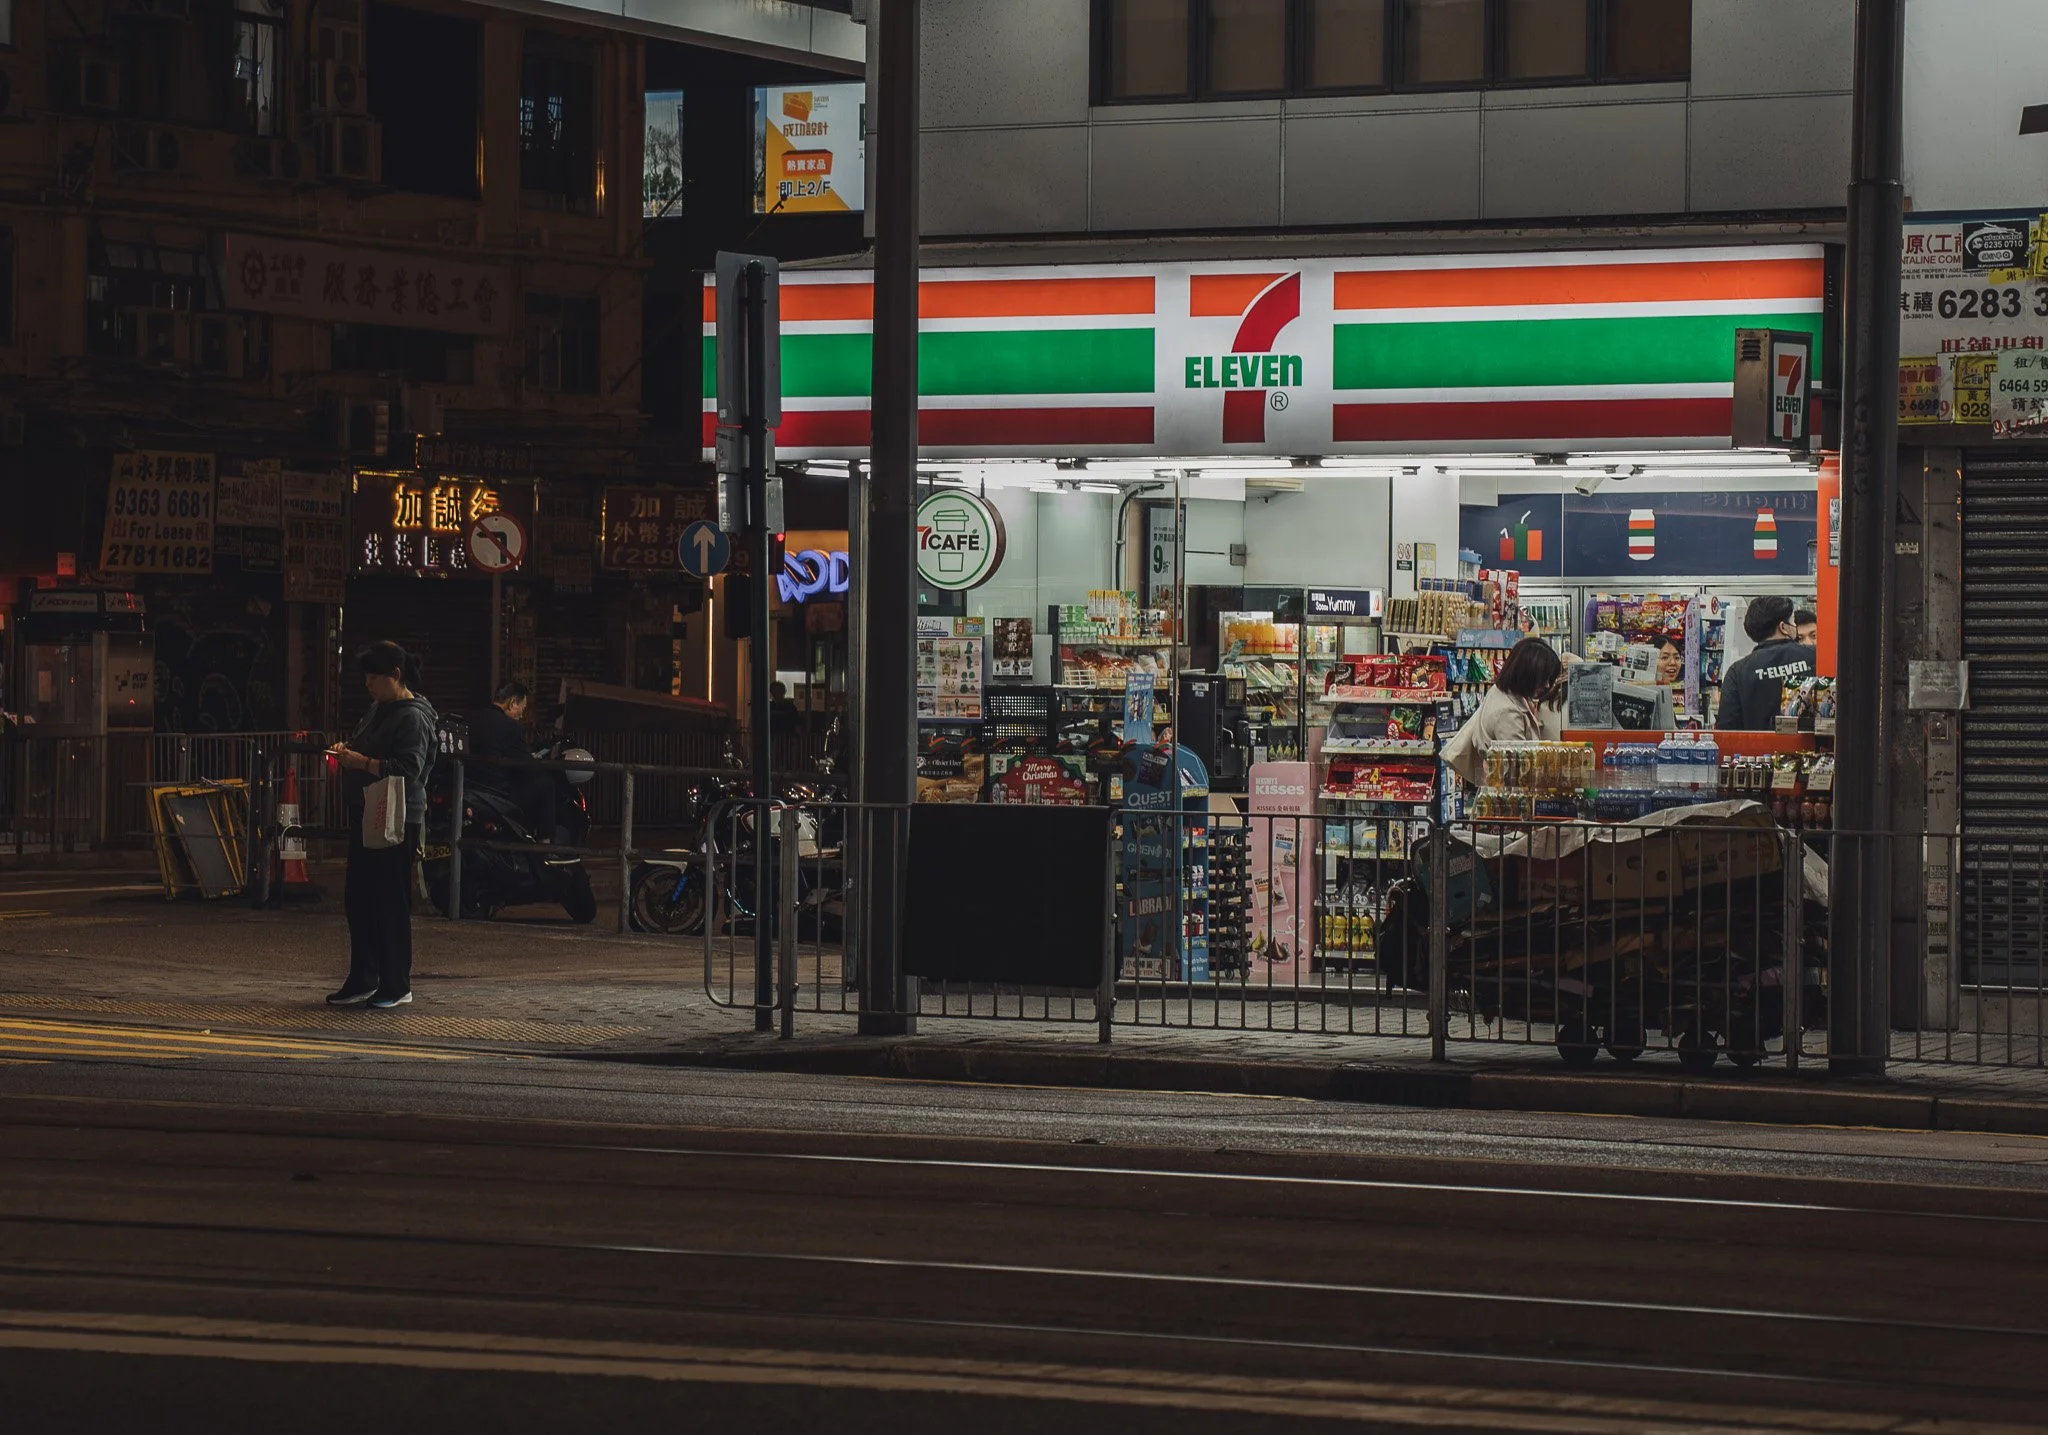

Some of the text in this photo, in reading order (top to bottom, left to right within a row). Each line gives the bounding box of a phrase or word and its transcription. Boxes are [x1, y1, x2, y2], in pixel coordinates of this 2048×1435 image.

[1938, 288, 2022, 319] 6283
[1999, 380, 2030, 395] 6464
[114, 487, 160, 517] 9363
[167, 489, 210, 519] 6681
[129, 521, 151, 539] For
[154, 523, 193, 541] Lease
[1327, 596, 1356, 615] Yummy
[1022, 771, 1058, 782] Christmas
[1025, 763, 1052, 773] Merry
[1127, 790, 1173, 808] QUEST
